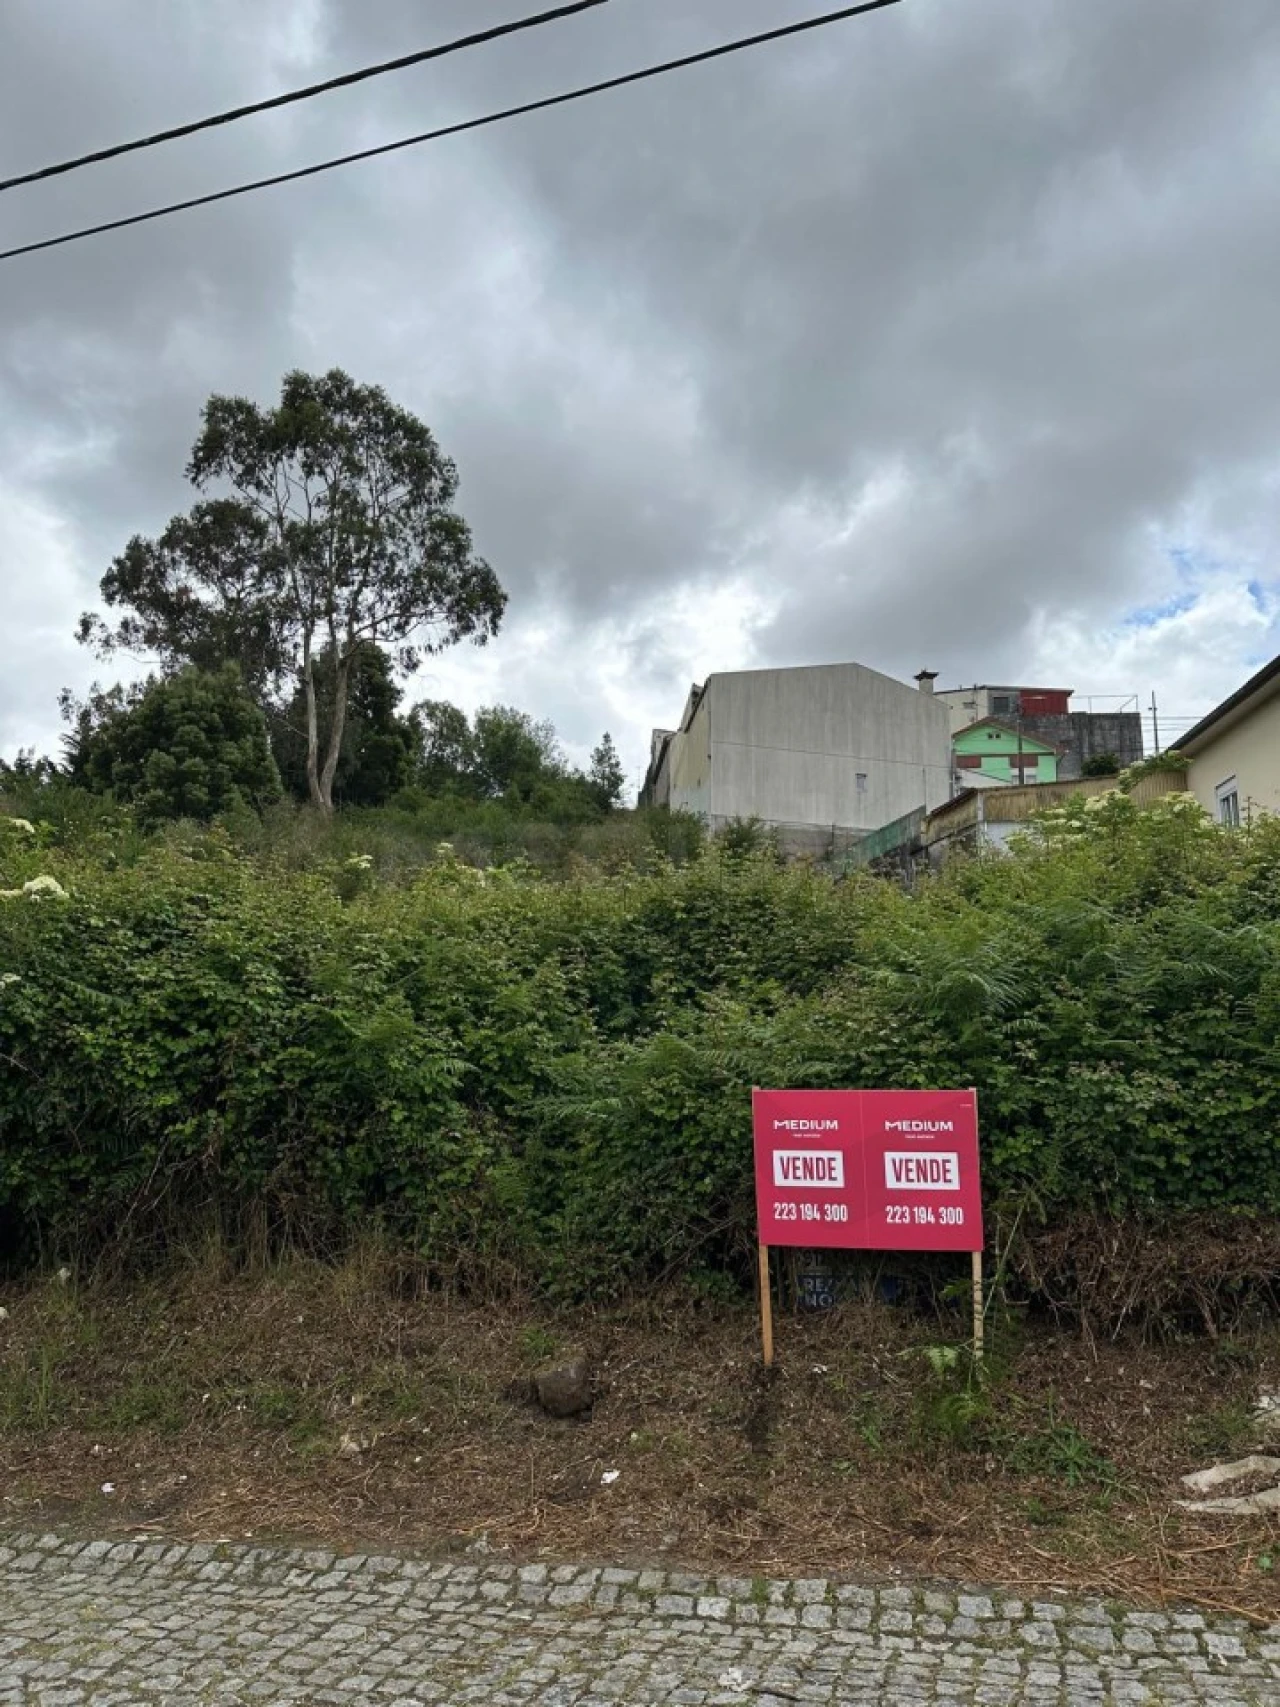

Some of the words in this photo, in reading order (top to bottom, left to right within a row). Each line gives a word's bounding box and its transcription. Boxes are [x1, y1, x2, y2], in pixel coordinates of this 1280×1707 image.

[774, 1120, 838, 1130] MEDIUM
[885, 1120, 953, 1131] MEDIUM
[780, 1156, 838, 1181] VENDE
[892, 1158, 952, 1183] VENDE
[774, 1202, 797, 1220] 223
[799, 1203, 821, 1221] 194
[824, 1204, 848, 1222] 300
[885, 1205, 910, 1224] 223
[912, 1206, 935, 1225] 194
[938, 1207, 964, 1225] 300
